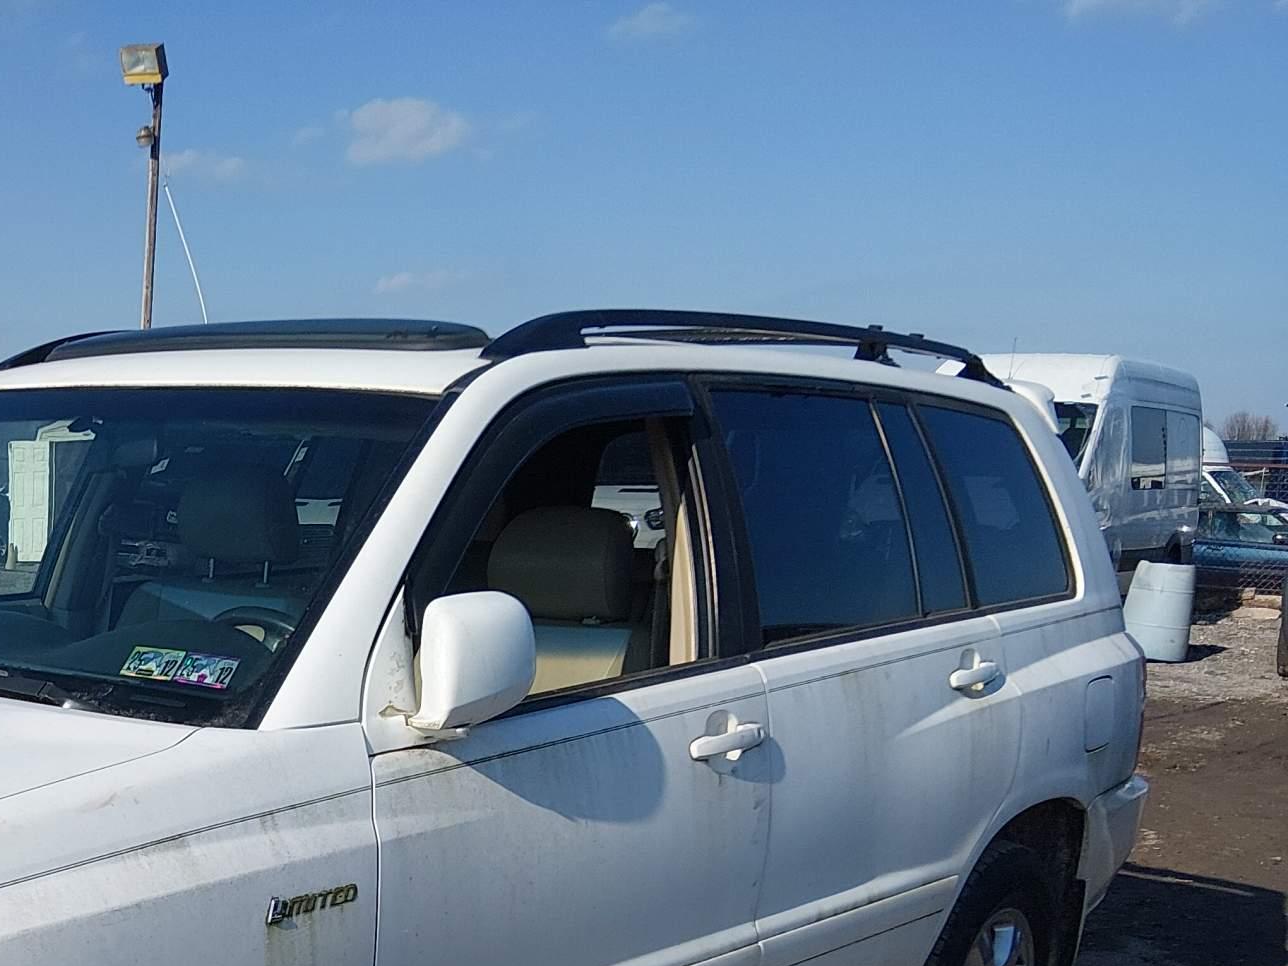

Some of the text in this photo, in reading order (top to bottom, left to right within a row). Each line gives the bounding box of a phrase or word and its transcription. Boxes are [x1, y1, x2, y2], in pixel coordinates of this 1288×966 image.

[160, 660, 179, 677] 12
[215, 667, 233, 685] 12
[265, 883, 359, 926] LIMITED
